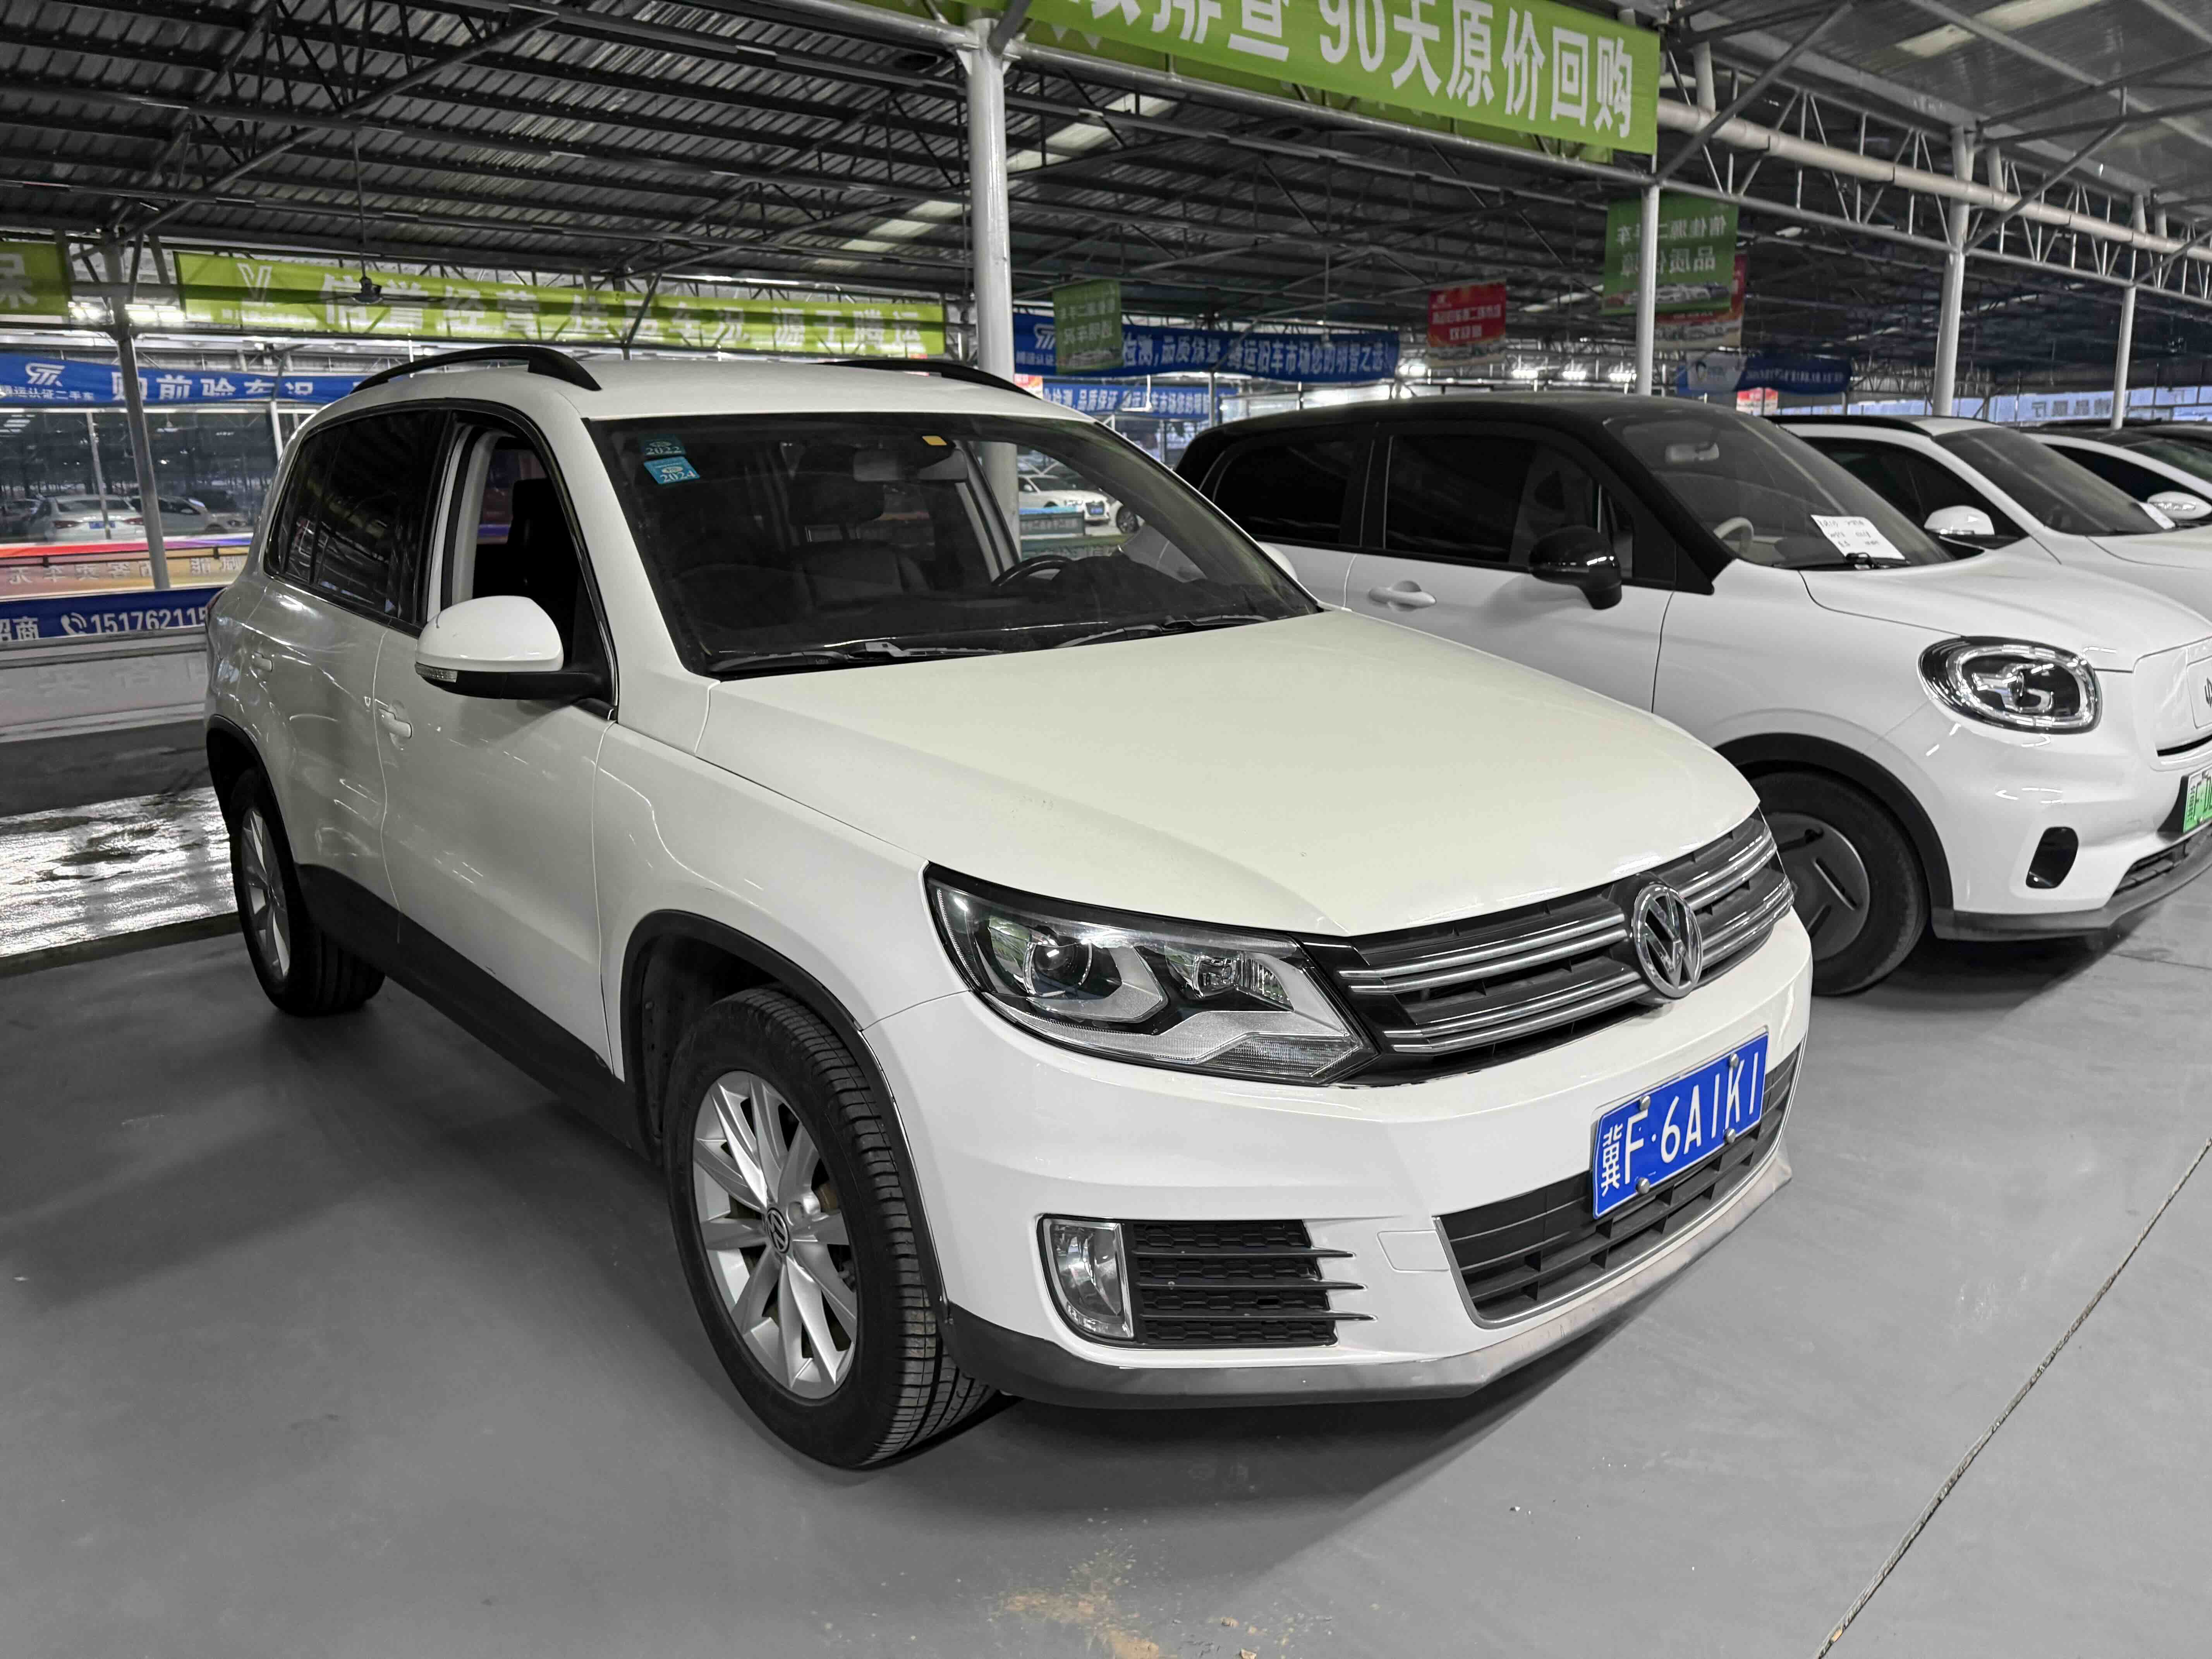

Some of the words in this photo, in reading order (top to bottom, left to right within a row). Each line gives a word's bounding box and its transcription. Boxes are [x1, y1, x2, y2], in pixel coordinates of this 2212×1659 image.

[1319, 0, 1633, 138] 90天原价回购
[646, 446, 682, 455] 2022
[660, 470, 696, 483] 2024
